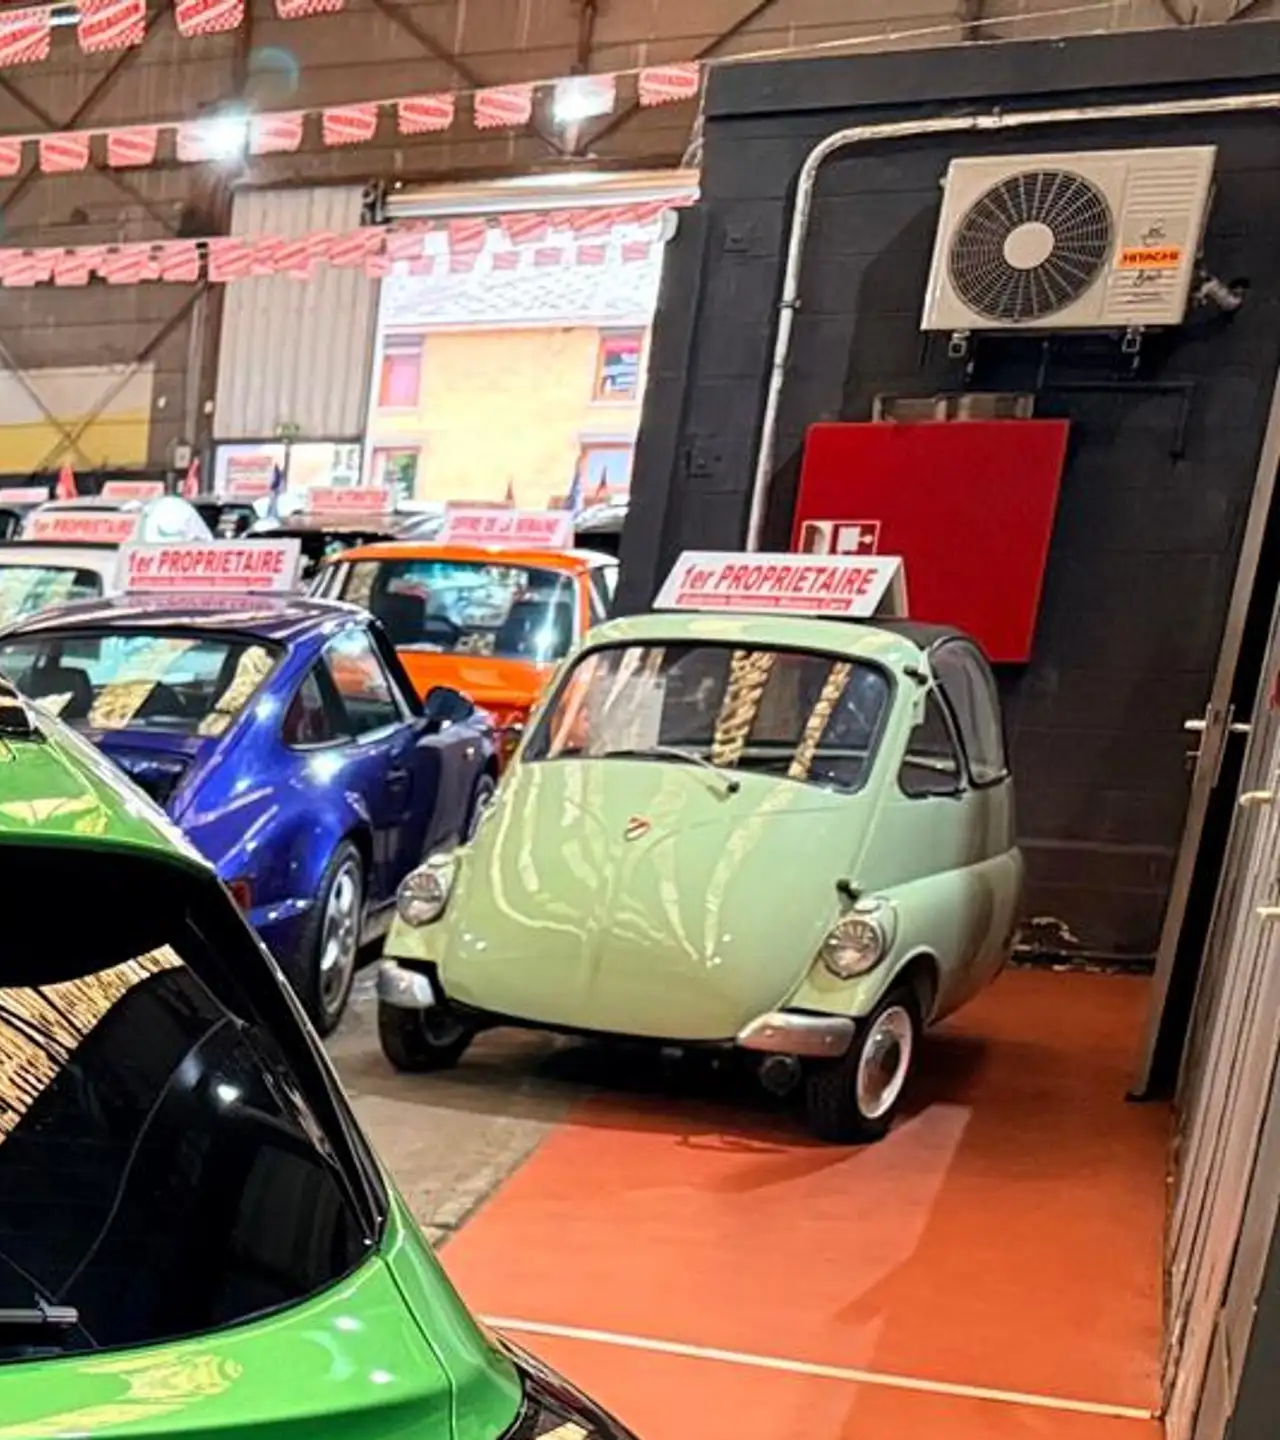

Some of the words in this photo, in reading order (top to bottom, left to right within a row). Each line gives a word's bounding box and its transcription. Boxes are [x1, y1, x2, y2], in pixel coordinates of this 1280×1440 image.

[128, 550, 154, 573] 1er
[157, 549, 286, 574] PROPRIETAIRE
[680, 564, 717, 590] 1er
[714, 563, 879, 596] PROPRIETAIRE
